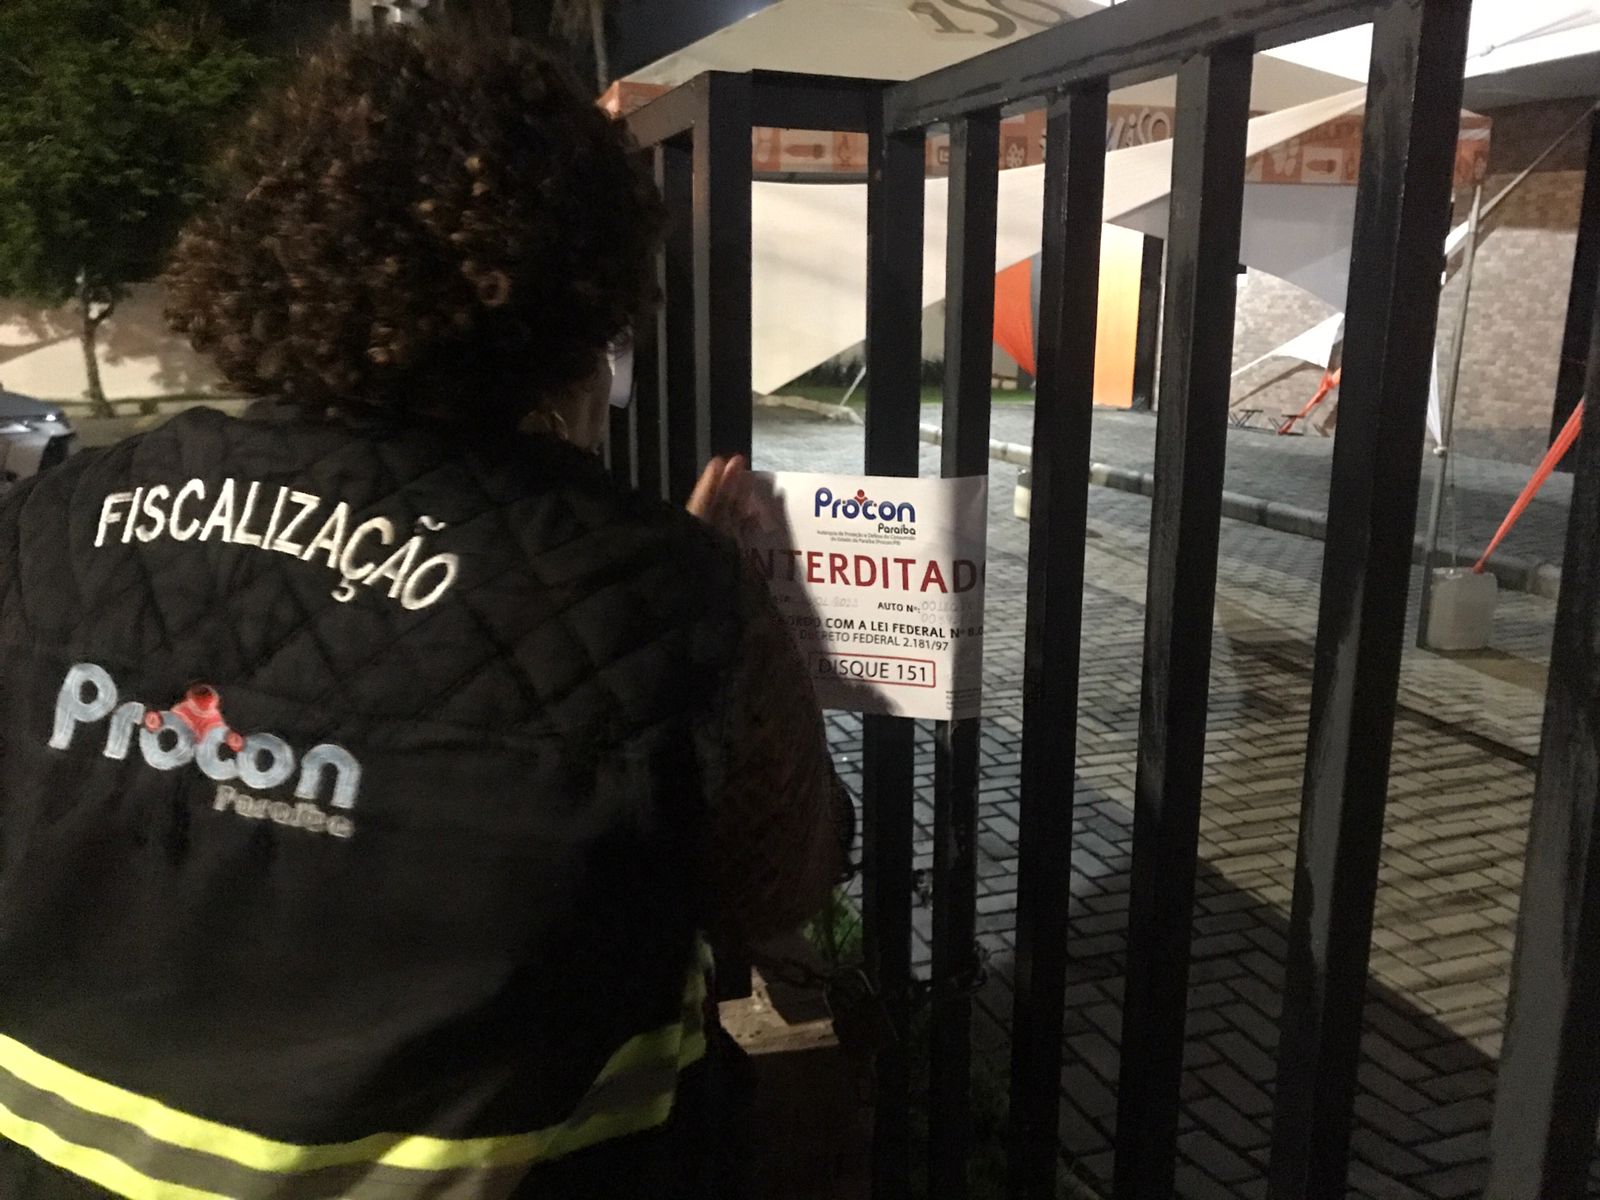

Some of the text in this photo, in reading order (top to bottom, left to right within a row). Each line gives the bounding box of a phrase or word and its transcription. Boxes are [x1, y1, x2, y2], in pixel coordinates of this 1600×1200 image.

[814, 486, 916, 523] Procon
[95, 478, 459, 610] FISCALIZAÇÃO
[878, 601, 904, 612] AUTO
[826, 617, 854, 629] COM
[859, 620, 867, 630] A
[871, 621, 888, 632] LEI
[893, 623, 946, 638] FEDERAL
[853, 632, 900, 646] FEDERAL
[903, 638, 949, 651] 2.181/97
[819, 658, 926, 682] DISQUE 151
[48, 662, 362, 809] Procon
